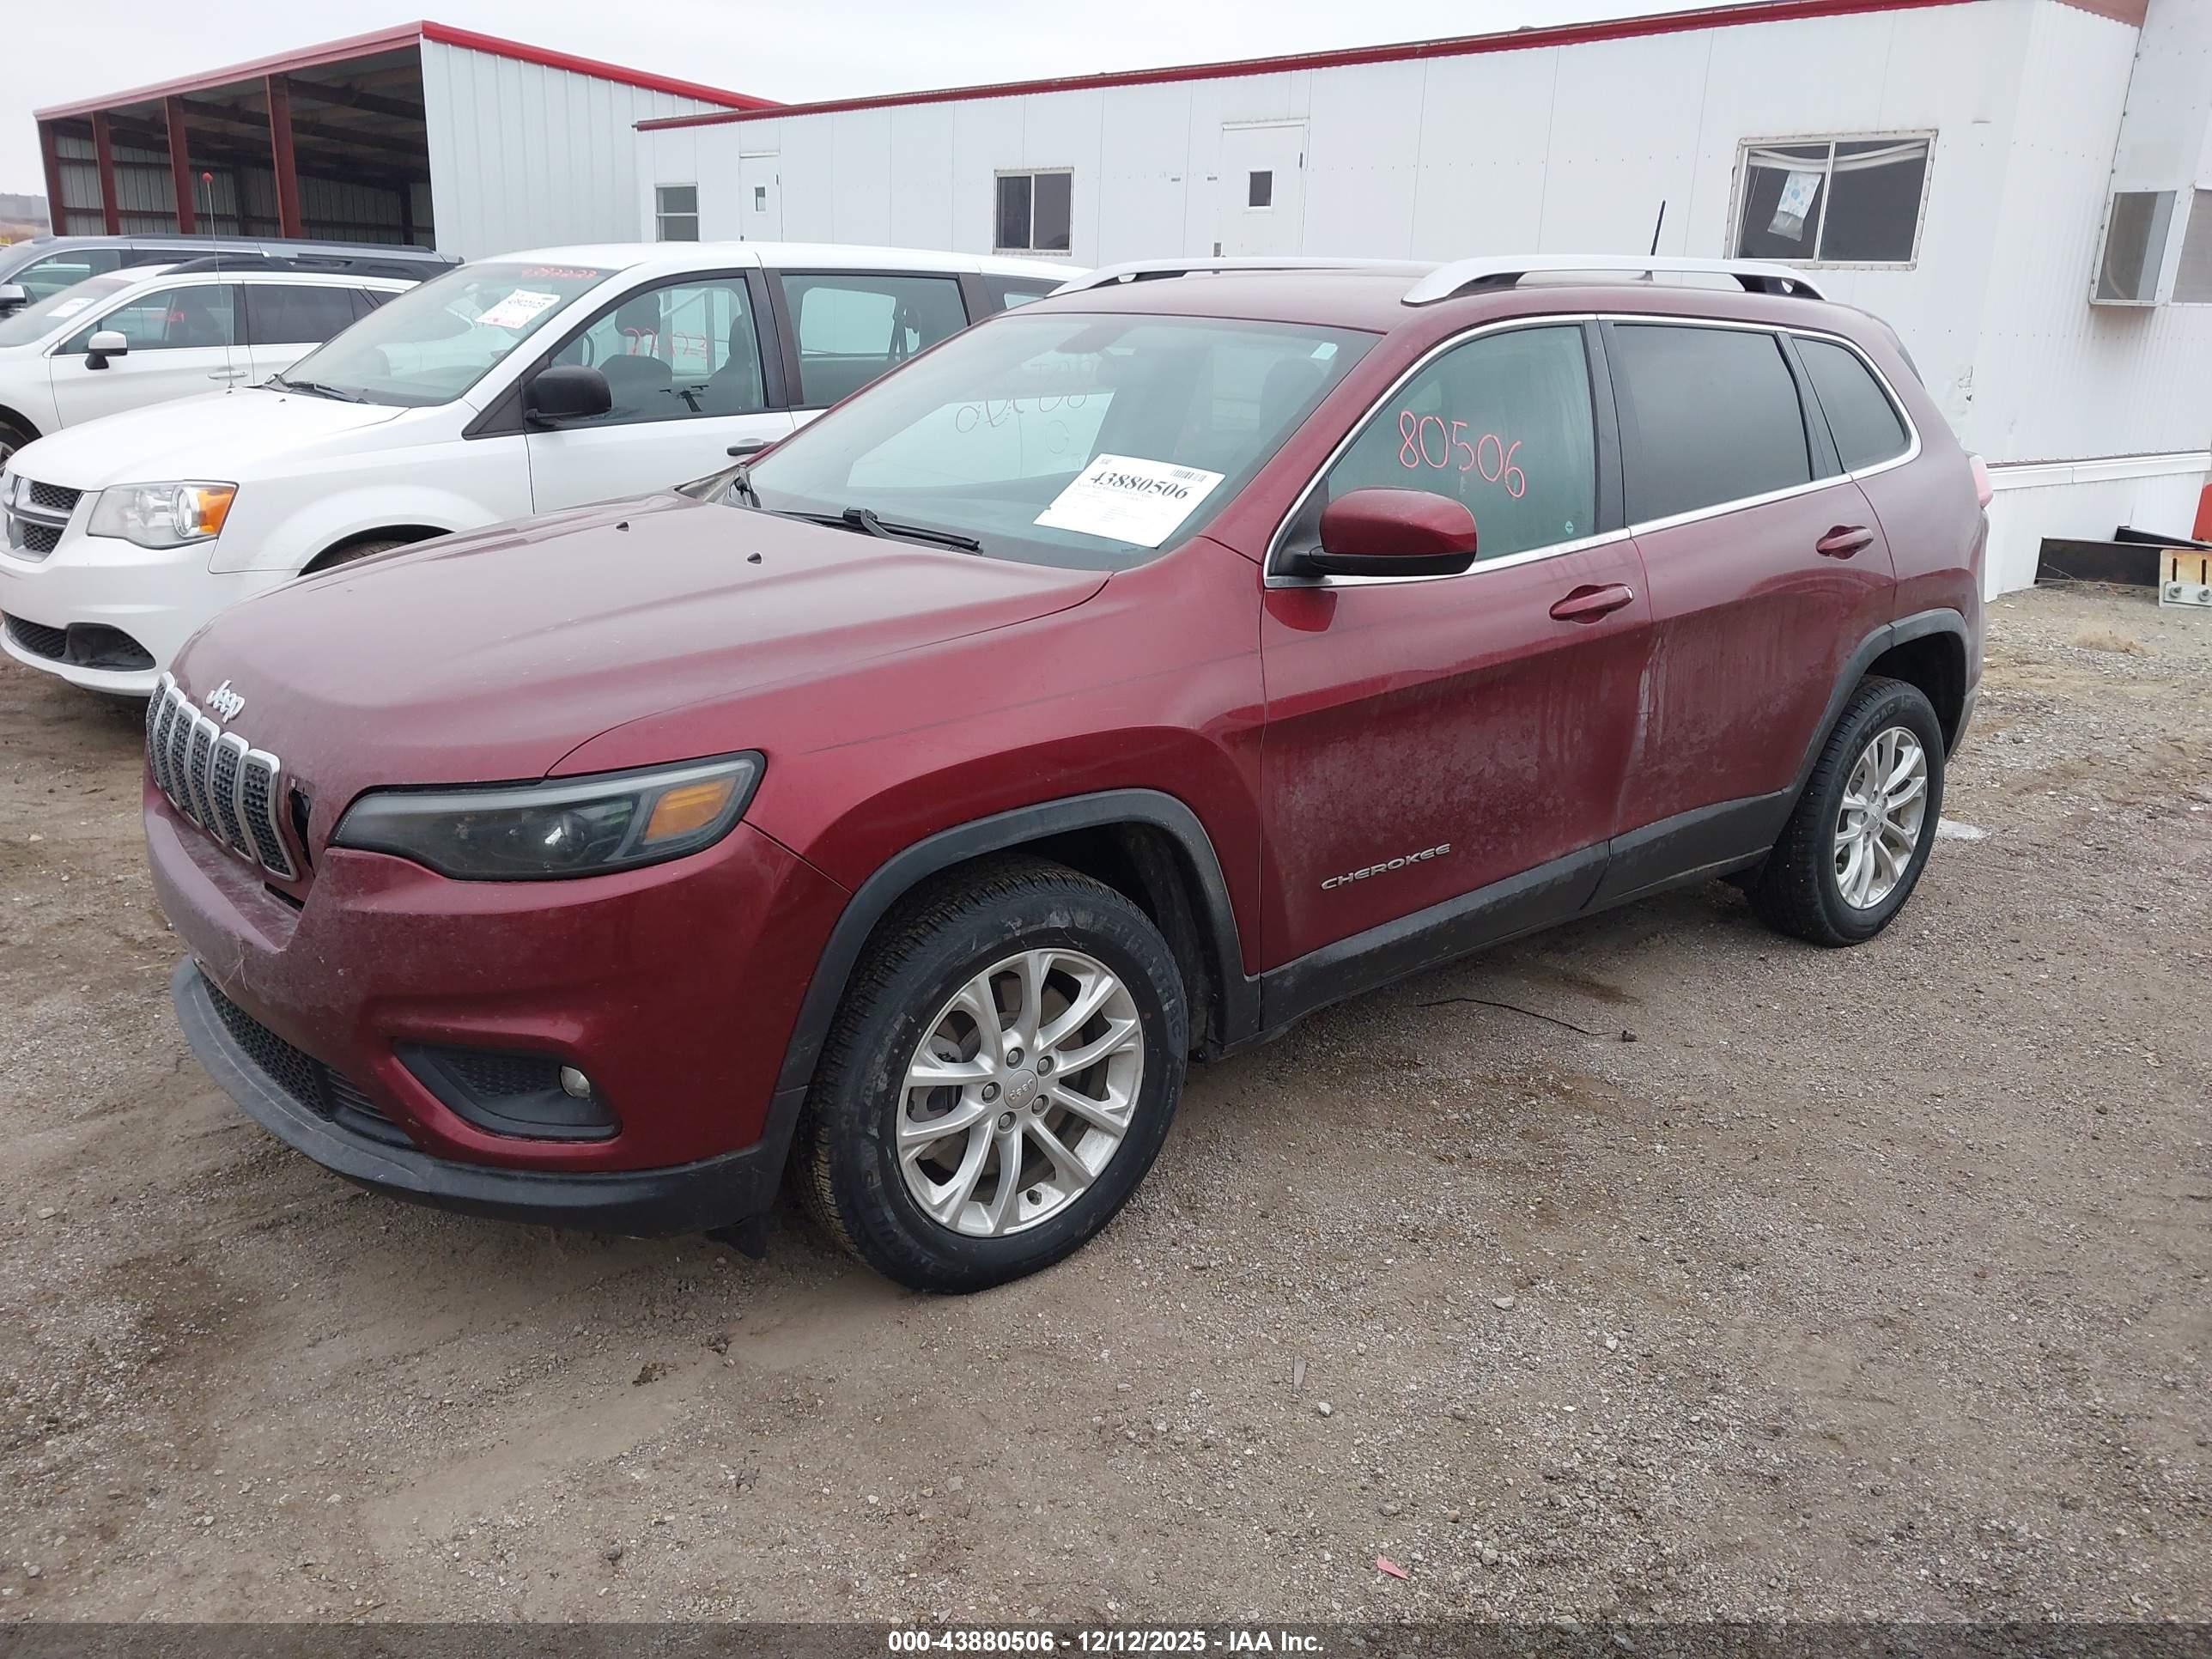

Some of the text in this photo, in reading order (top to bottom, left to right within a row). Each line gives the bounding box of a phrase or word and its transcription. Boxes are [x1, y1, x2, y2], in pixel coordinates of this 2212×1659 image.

[1398, 410, 1526, 498] 80506
[1091, 471, 1194, 500] 43880506
[205, 678, 246, 724] Jeep
[1320, 843, 1451, 890] CHEROKEE
[1009, 1078, 1034, 1101] Jeep
